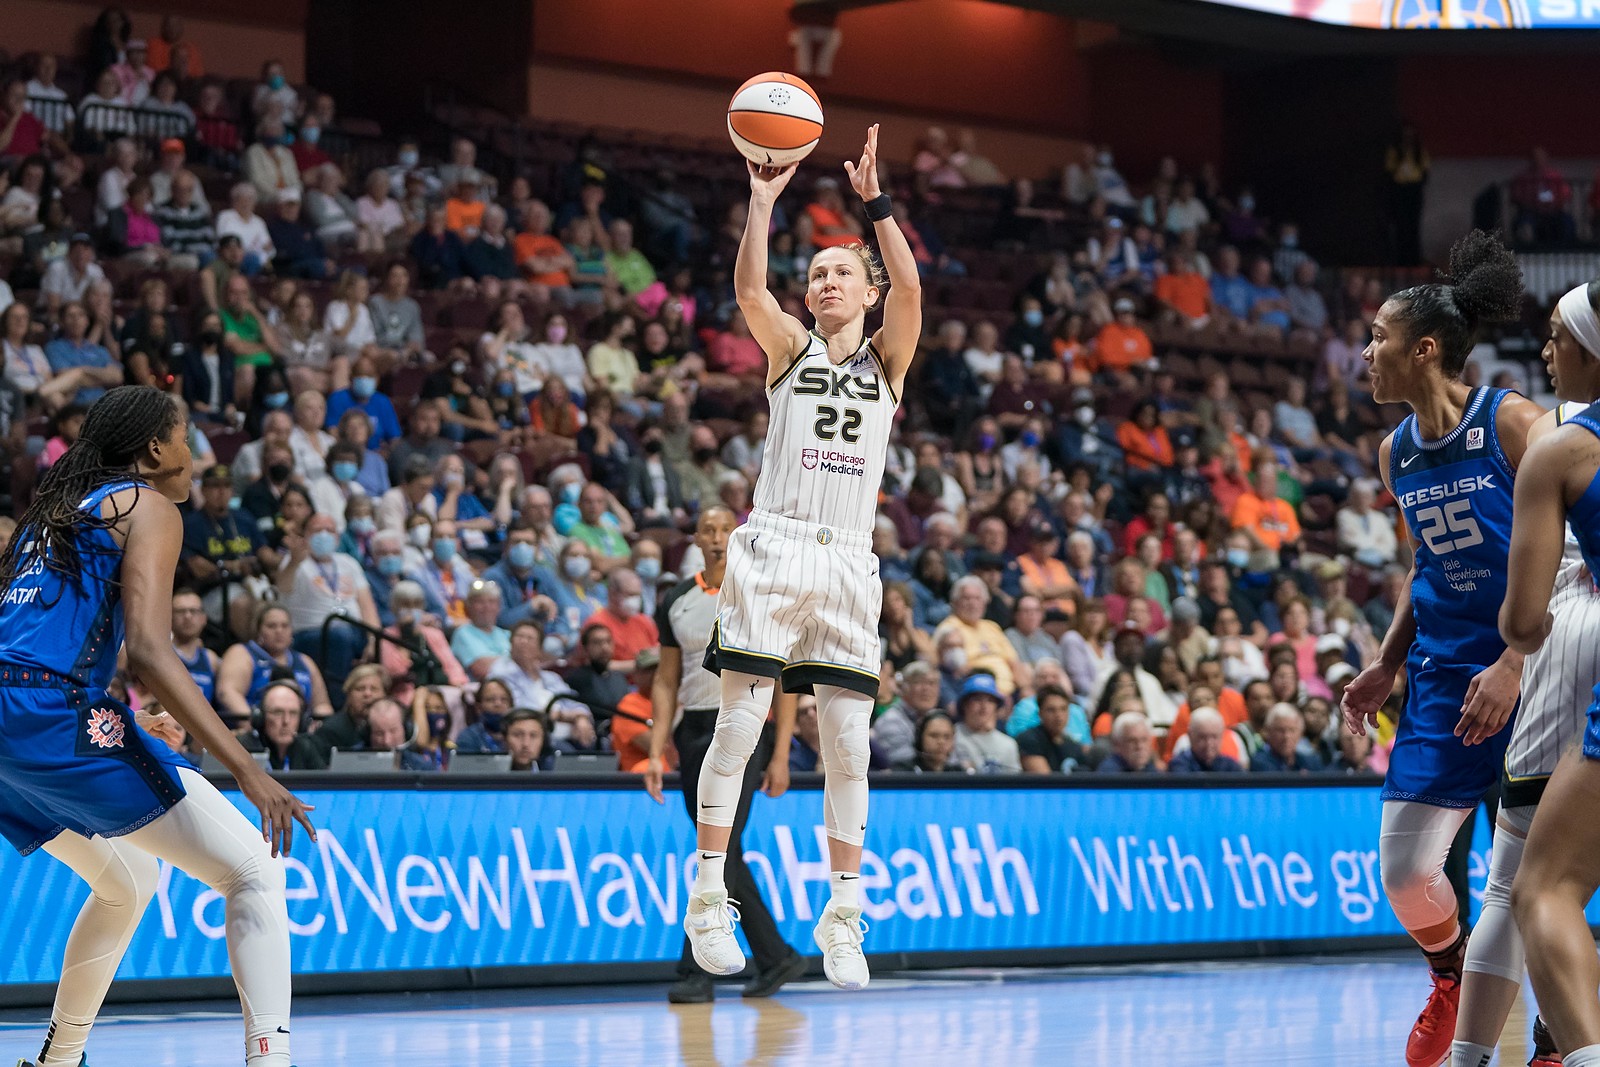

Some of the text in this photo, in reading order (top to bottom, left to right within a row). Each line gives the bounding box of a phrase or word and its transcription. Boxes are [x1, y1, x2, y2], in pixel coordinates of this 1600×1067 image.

[792, 366, 880, 403] SKY
[813, 404, 863, 445] 22
[820, 462, 864, 477] Medicine
[822, 450, 865, 466] UChicago
[1399, 474, 1496, 509] KEESUSK
[1415, 498, 1484, 555] 25
[1442, 558, 1461, 571] Yale
[1069, 835, 1214, 913] With
[1222, 834, 1318, 909] the
